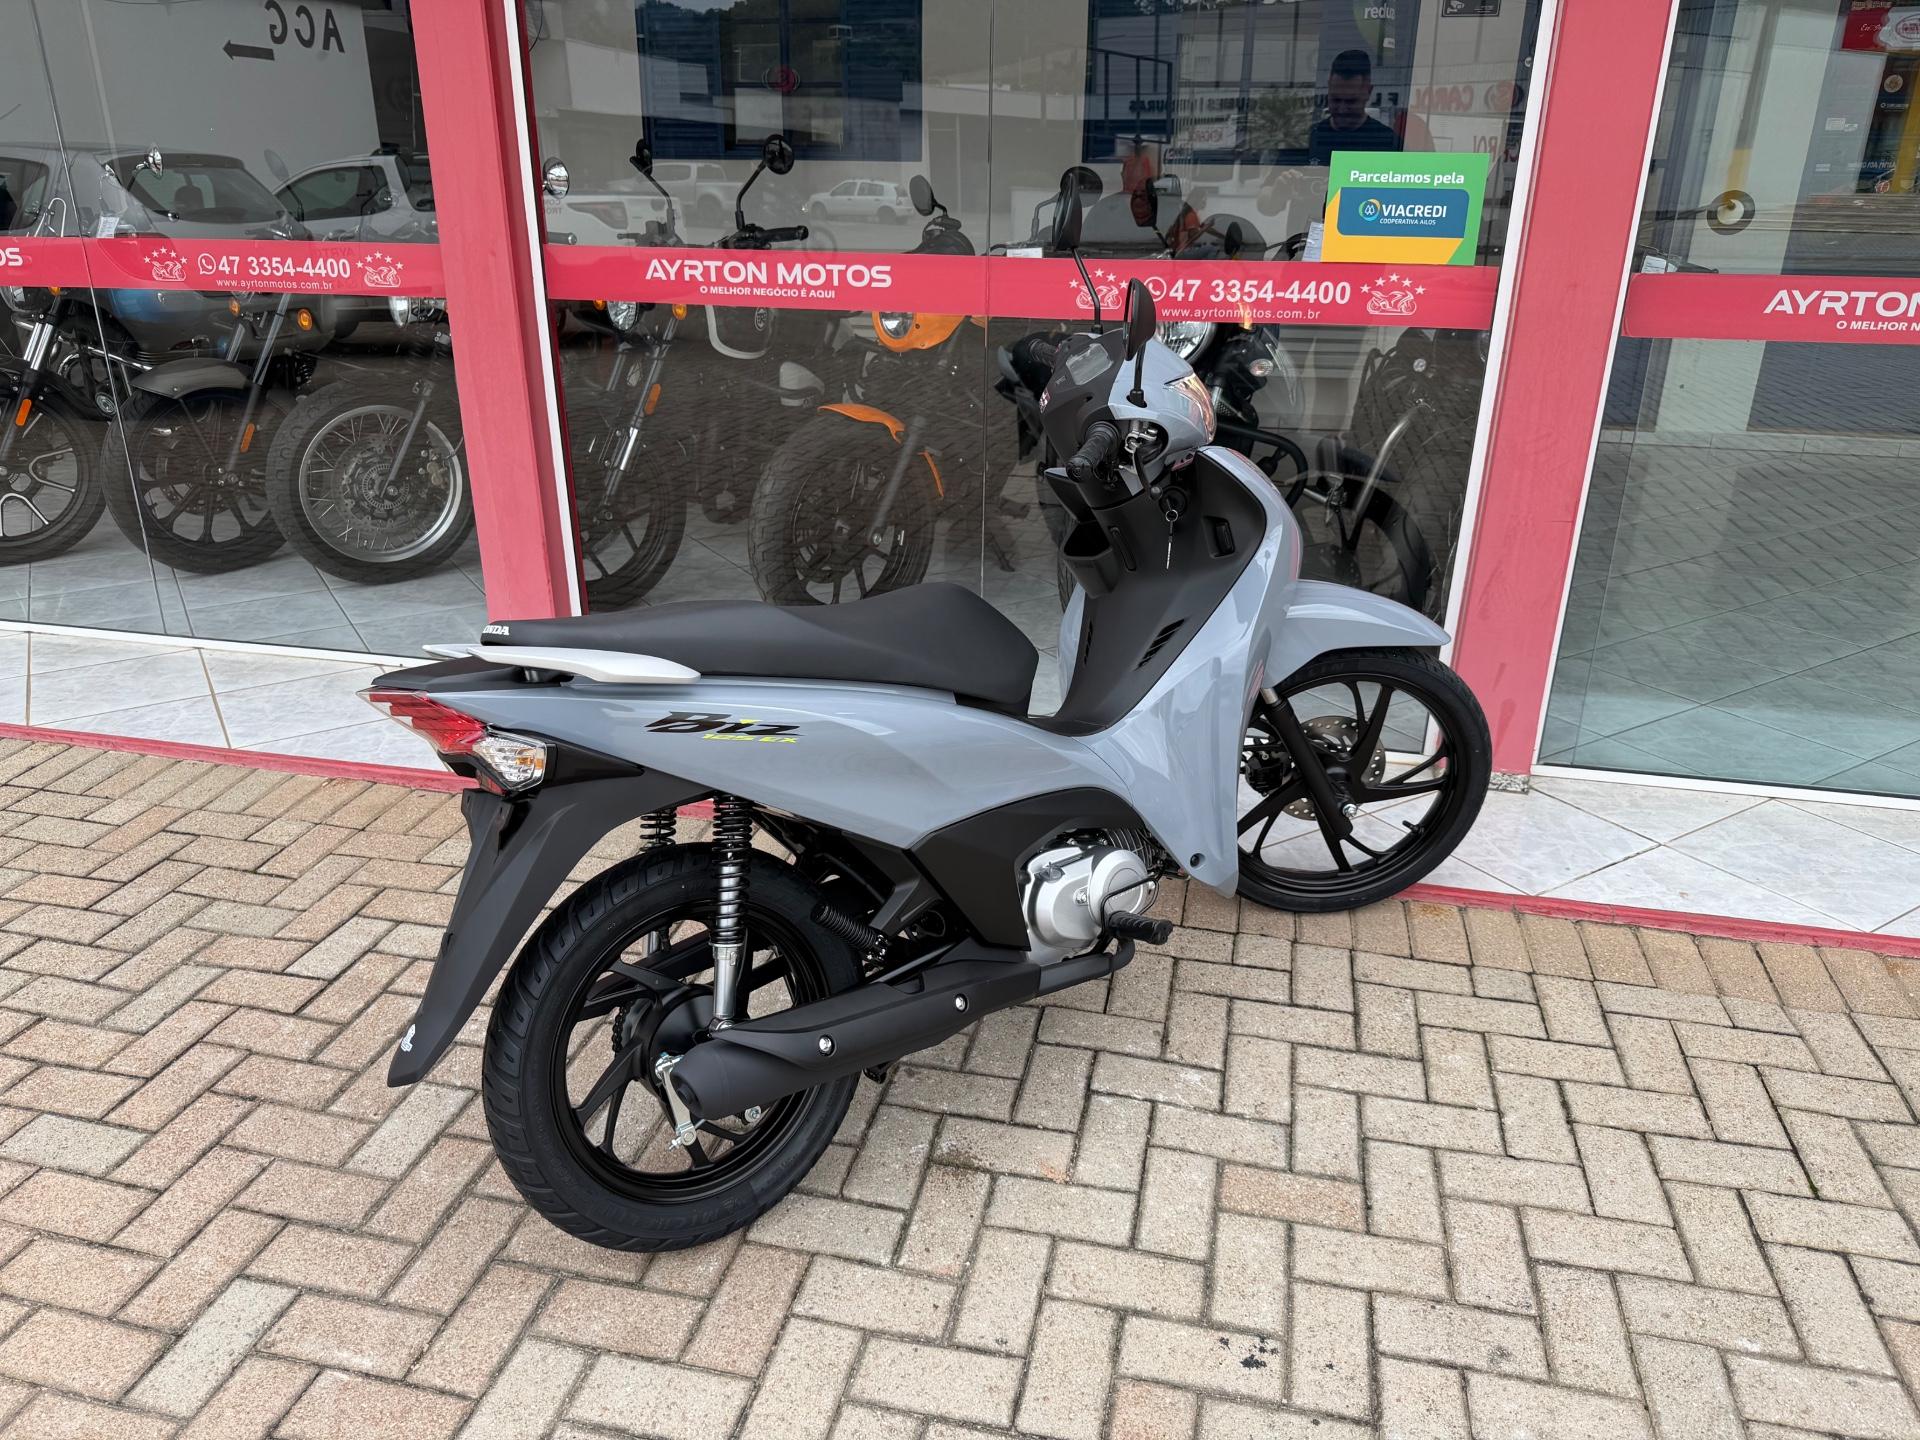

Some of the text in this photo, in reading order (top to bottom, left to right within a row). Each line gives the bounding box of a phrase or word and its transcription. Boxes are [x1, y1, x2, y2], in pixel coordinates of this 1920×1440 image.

[1350, 170, 1465, 187] Parcelamos pela
[1381, 204, 1447, 218] VIACREDI
[1379, 218, 1419, 226] COOPERATIVA
[218, 255, 351, 279] 47 3354-4400
[645, 258, 893, 288] AYRTON MOTOS
[216, 278, 332, 290] www.ayrtonmotos.com.br
[700, 285, 836, 299] O MELHOR NEGÓCIO É AQUI
[1169, 278, 1352, 305] 47 3354-4400
[1161, 306, 1321, 320] www.ayrtonmotos.com.br
[1836, 320, 1848, 330] O
[1850, 320, 1908, 331] MELHOR
[643, 711, 806, 737] Biz
[702, 733, 798, 744] 125 EX
